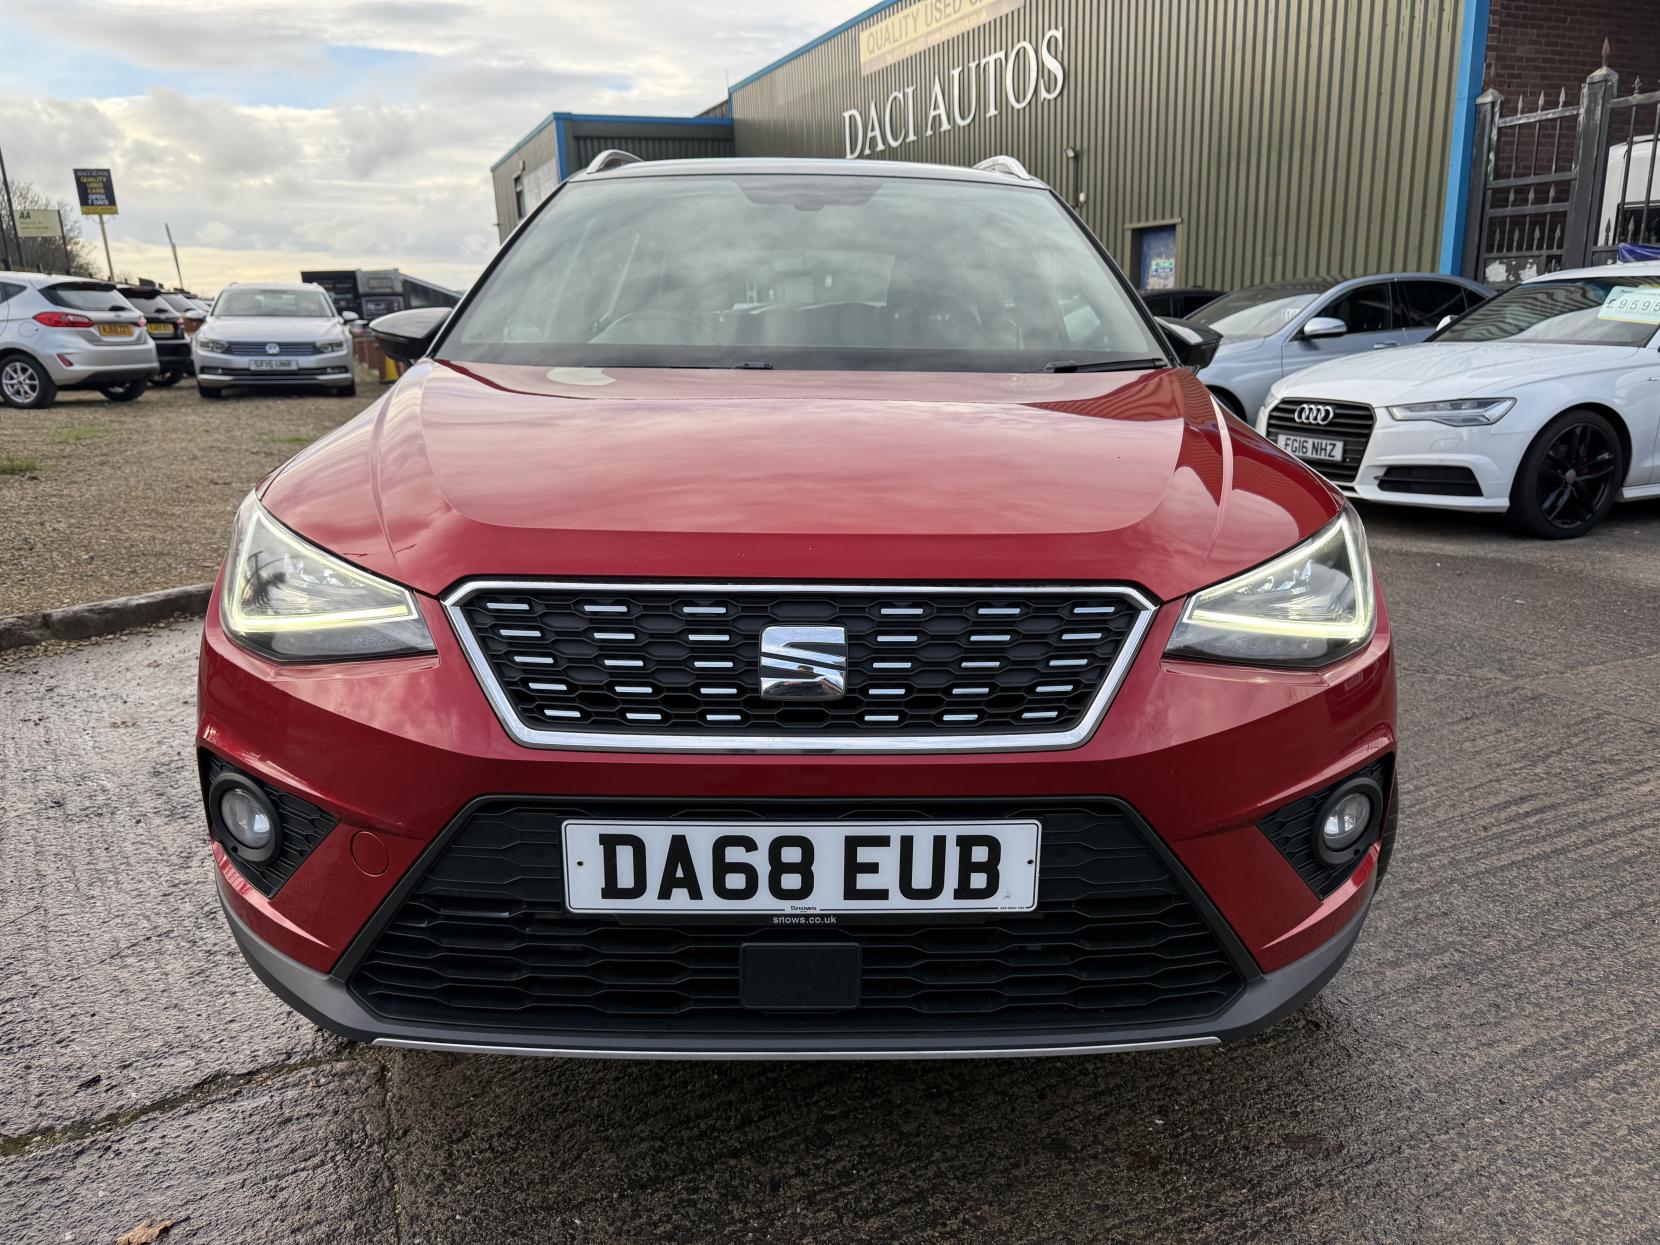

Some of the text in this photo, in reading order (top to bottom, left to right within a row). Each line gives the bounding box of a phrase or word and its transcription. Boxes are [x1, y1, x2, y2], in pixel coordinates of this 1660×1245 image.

[866, 8, 920, 56] QUALITY
[924, 0, 962, 27] USED
[843, 84, 918, 160] DACI
[925, 26, 1064, 137] AUTOS
[19, 211, 31, 219] AA
[1284, 437, 1336, 458] FG16 NHZ
[598, 833, 1003, 901] DA68 EUB
[772, 915, 837, 924] snows.co.uk
